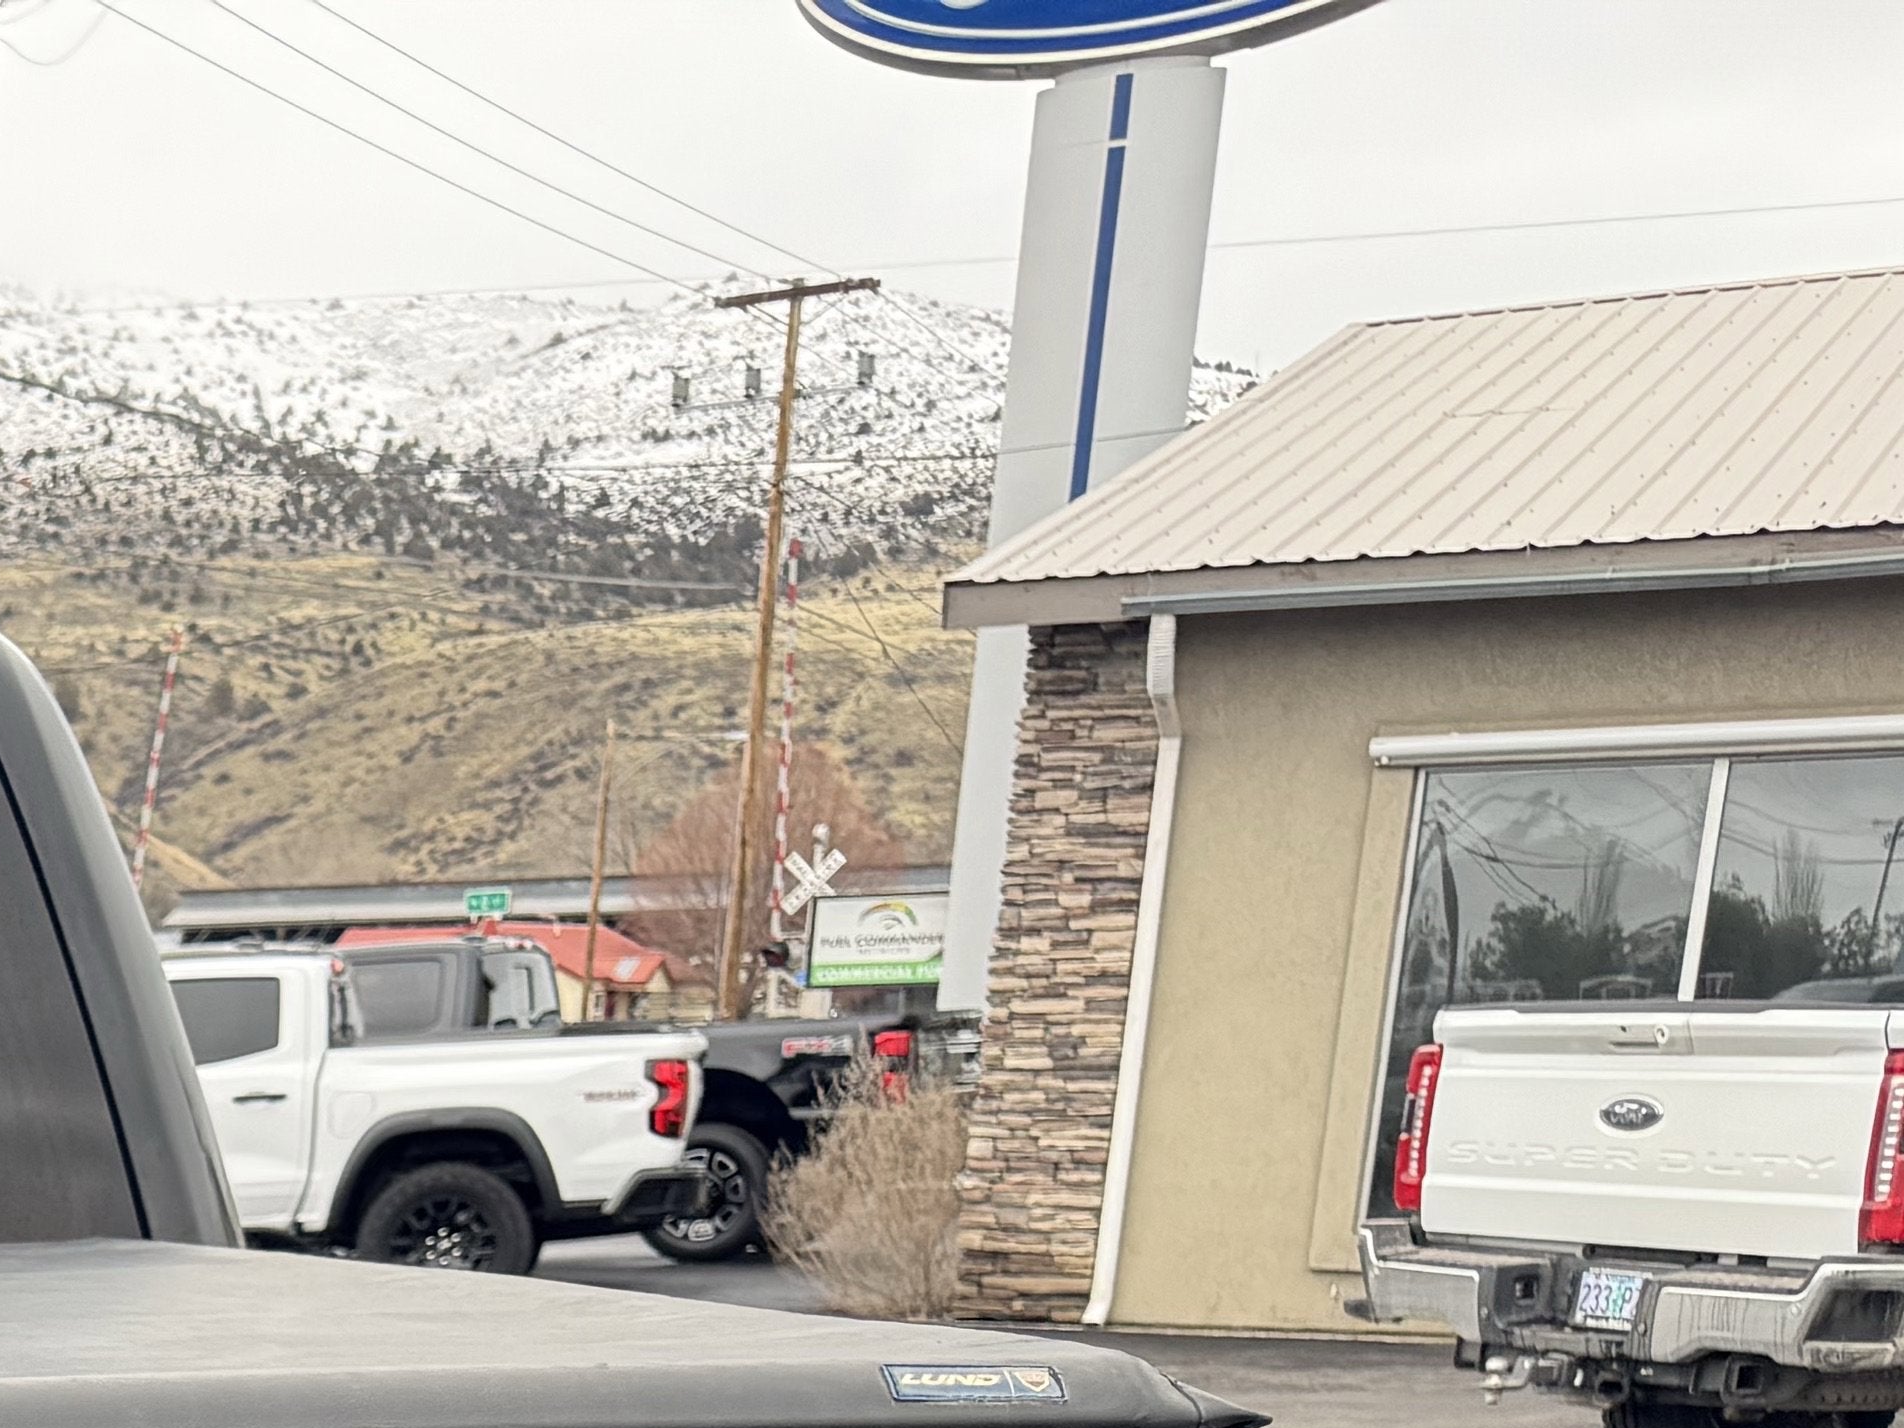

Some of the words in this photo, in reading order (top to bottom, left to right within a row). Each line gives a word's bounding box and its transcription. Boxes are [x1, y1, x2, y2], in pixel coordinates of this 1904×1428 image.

[1447, 1140, 1640, 1172] SUPER
[1658, 1148, 1837, 1181] DUTY
[901, 1373, 1002, 1386] LUND
